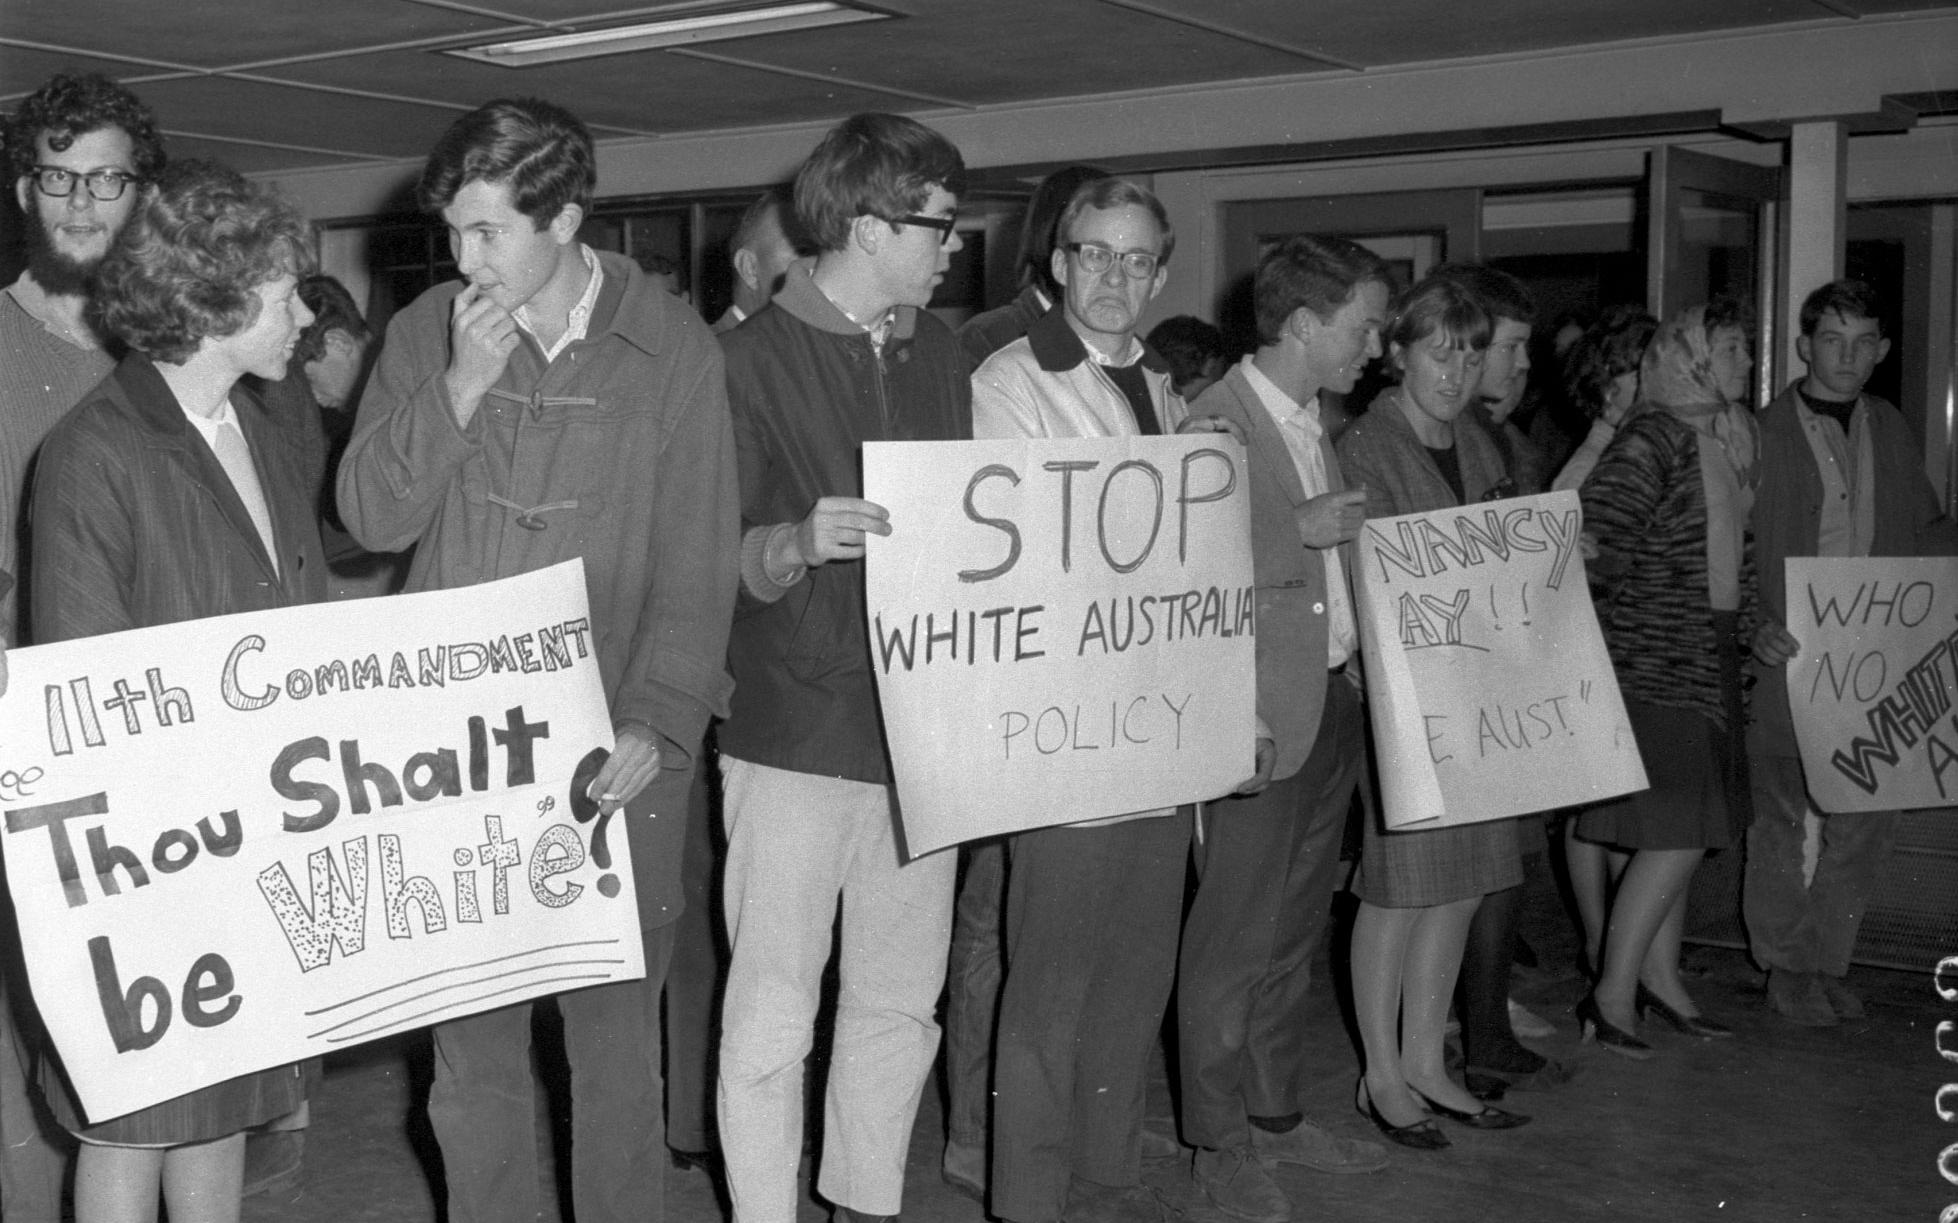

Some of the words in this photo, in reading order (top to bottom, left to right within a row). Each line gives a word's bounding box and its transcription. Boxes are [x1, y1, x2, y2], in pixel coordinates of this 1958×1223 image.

[957, 448, 1237, 583] STOP
[1366, 508, 1580, 591] NANCY
[875, 604, 1046, 674] WHITE
[1078, 585, 1255, 656] AUSTRALIA
[1808, 580, 1934, 627] WHO
[44, 667, 195, 755] 11th
[1810, 650, 1887, 703] NO
[270, 706, 550, 833] Shalt
[999, 693, 1192, 760] POLICY
[88, 935, 243, 1054] be
